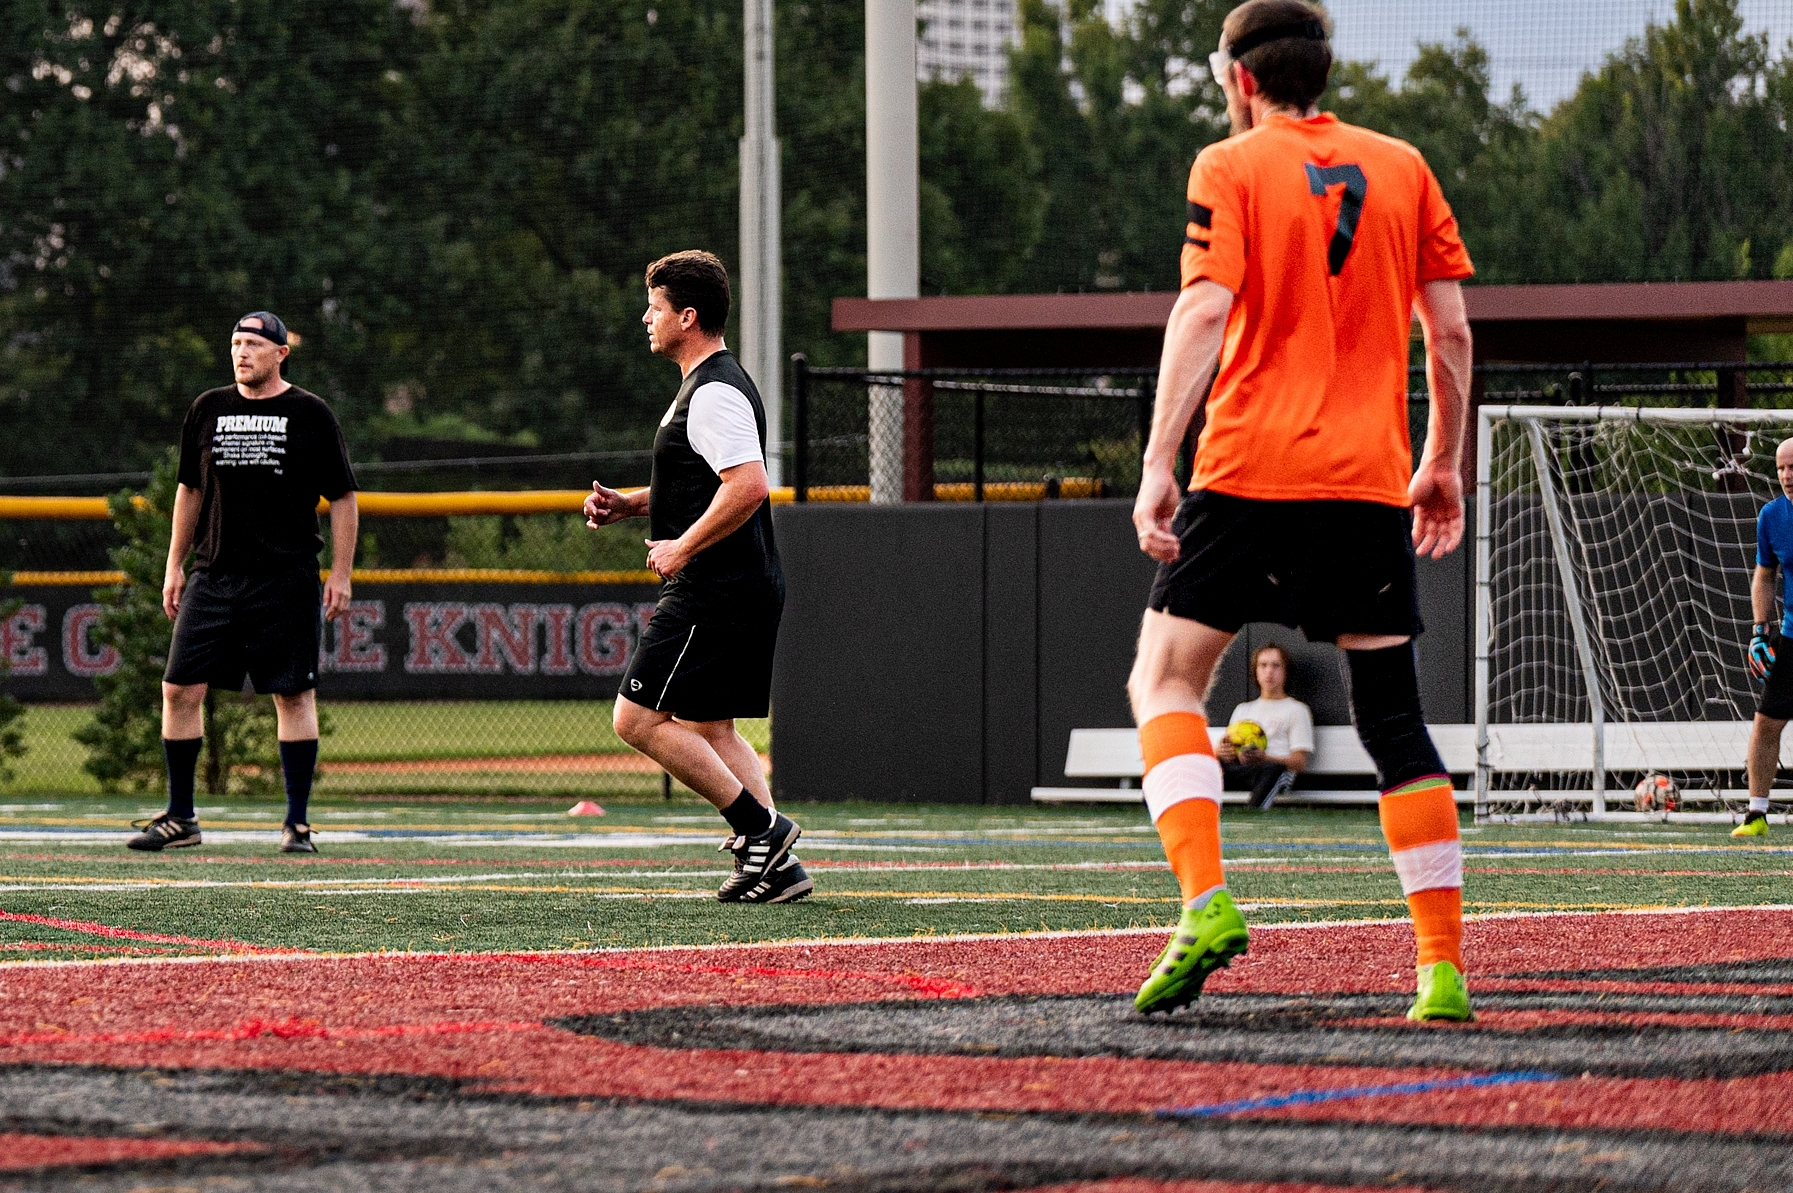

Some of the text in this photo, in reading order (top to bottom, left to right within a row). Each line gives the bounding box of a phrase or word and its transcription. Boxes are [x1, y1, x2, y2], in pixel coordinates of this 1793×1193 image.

[1303, 162, 1368, 277] 7
[216, 415, 288, 433] PREMIUM
[403, 601, 655, 677] KNIG
